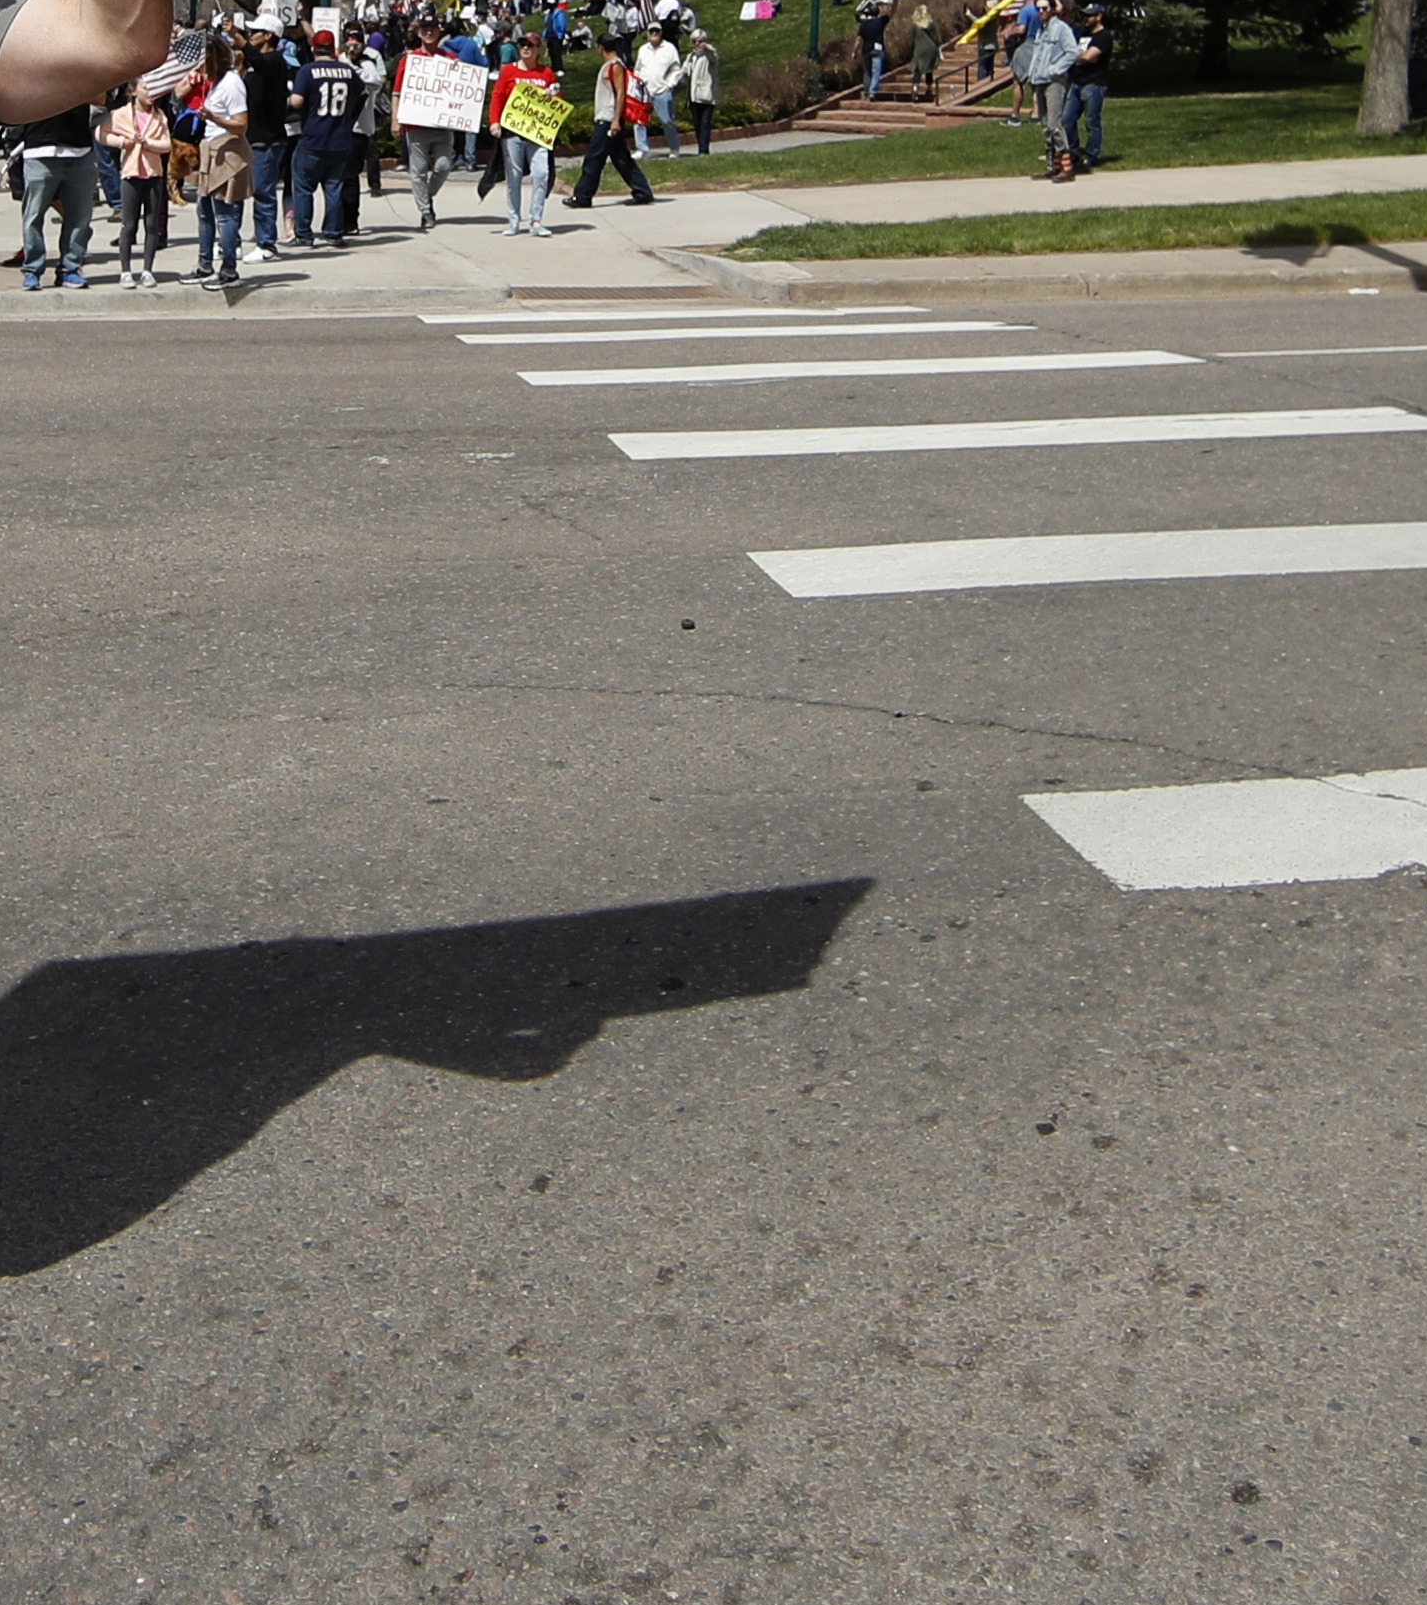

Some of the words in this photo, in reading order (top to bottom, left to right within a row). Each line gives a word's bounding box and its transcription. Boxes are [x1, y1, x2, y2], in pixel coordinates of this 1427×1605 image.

[317, 81, 349, 117] 18
[403, 91, 444, 109] FACT
[406, 74, 485, 103] COLORADO
[437, 113, 473, 130] FEAR
[511, 96, 560, 130] Colorado
